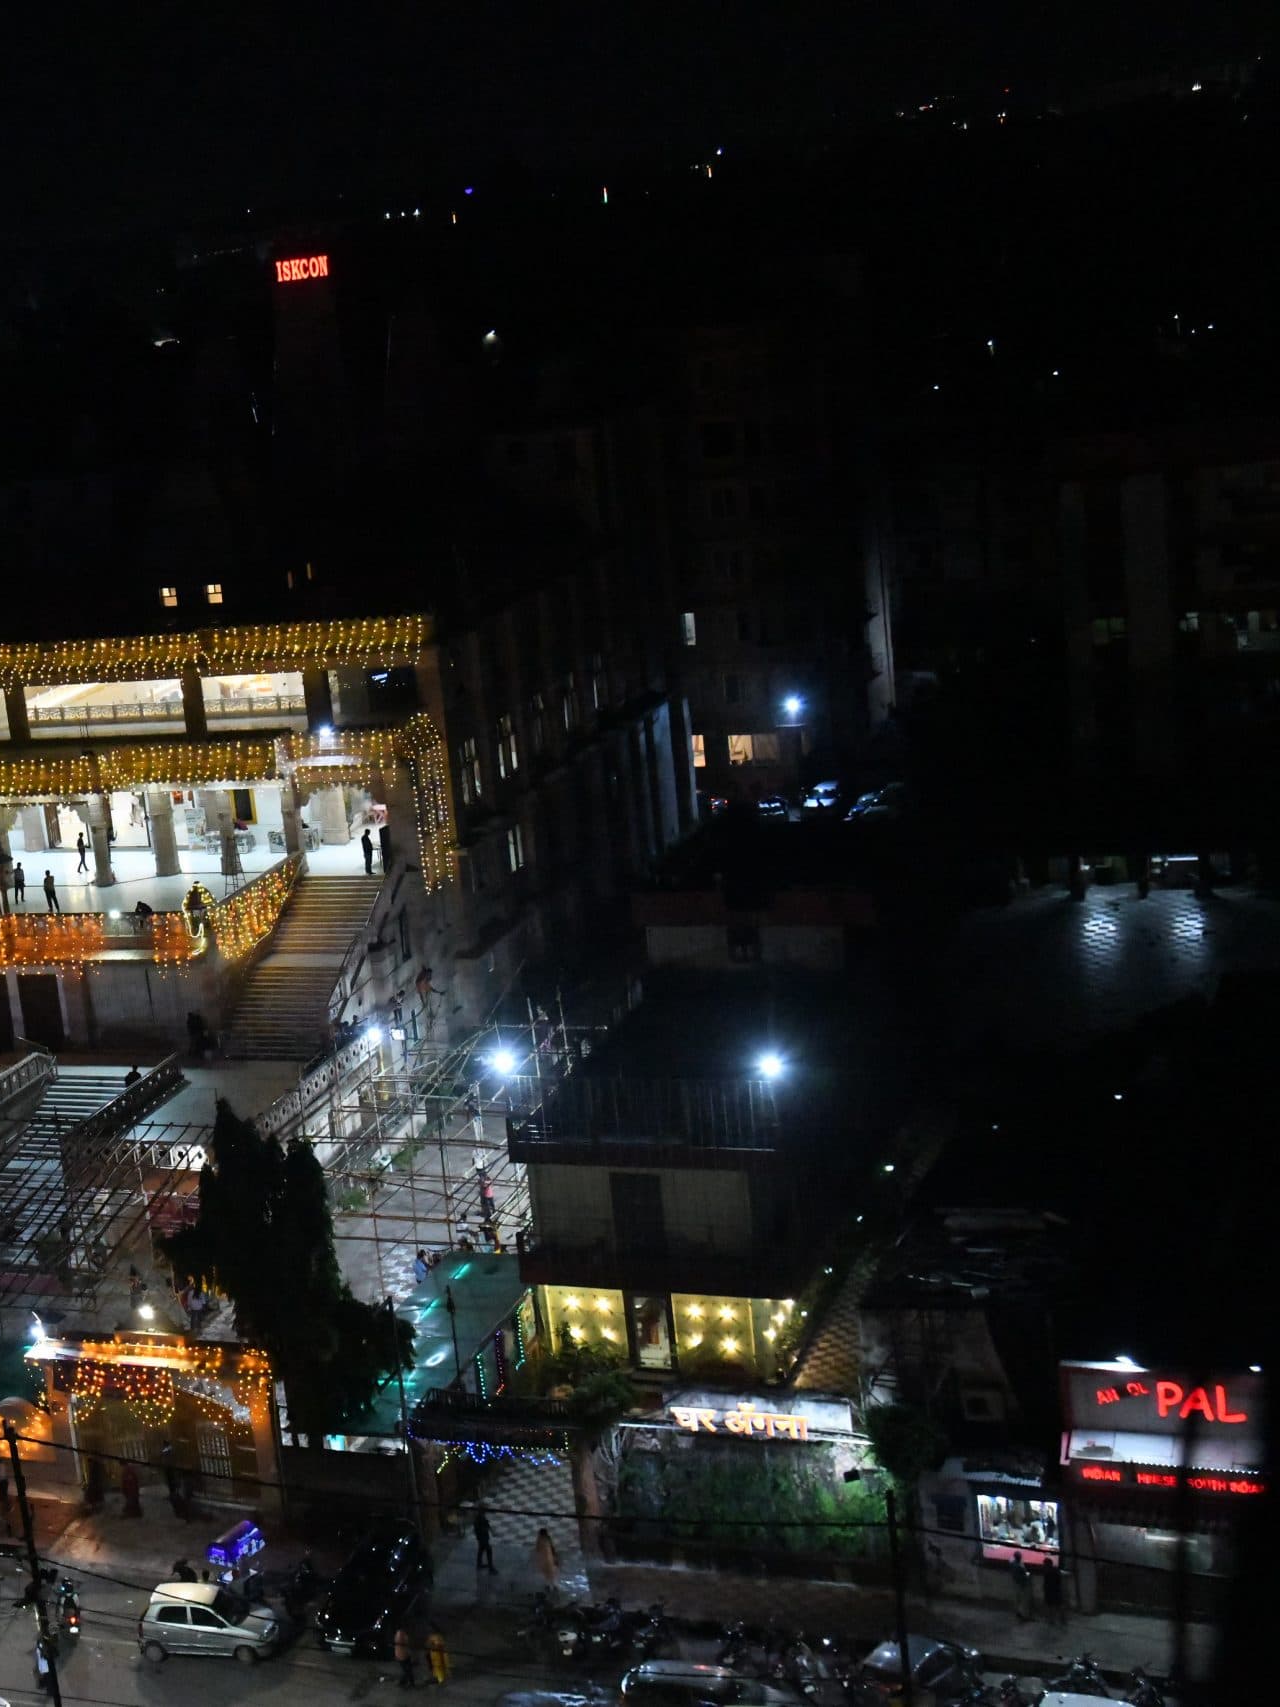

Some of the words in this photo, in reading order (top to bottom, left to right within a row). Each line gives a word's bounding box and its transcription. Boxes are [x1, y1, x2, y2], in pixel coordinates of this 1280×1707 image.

[275, 255, 329, 283] ISKCON
[1157, 1380, 1246, 1423] PAL
[670, 1406, 717, 1432] घर
